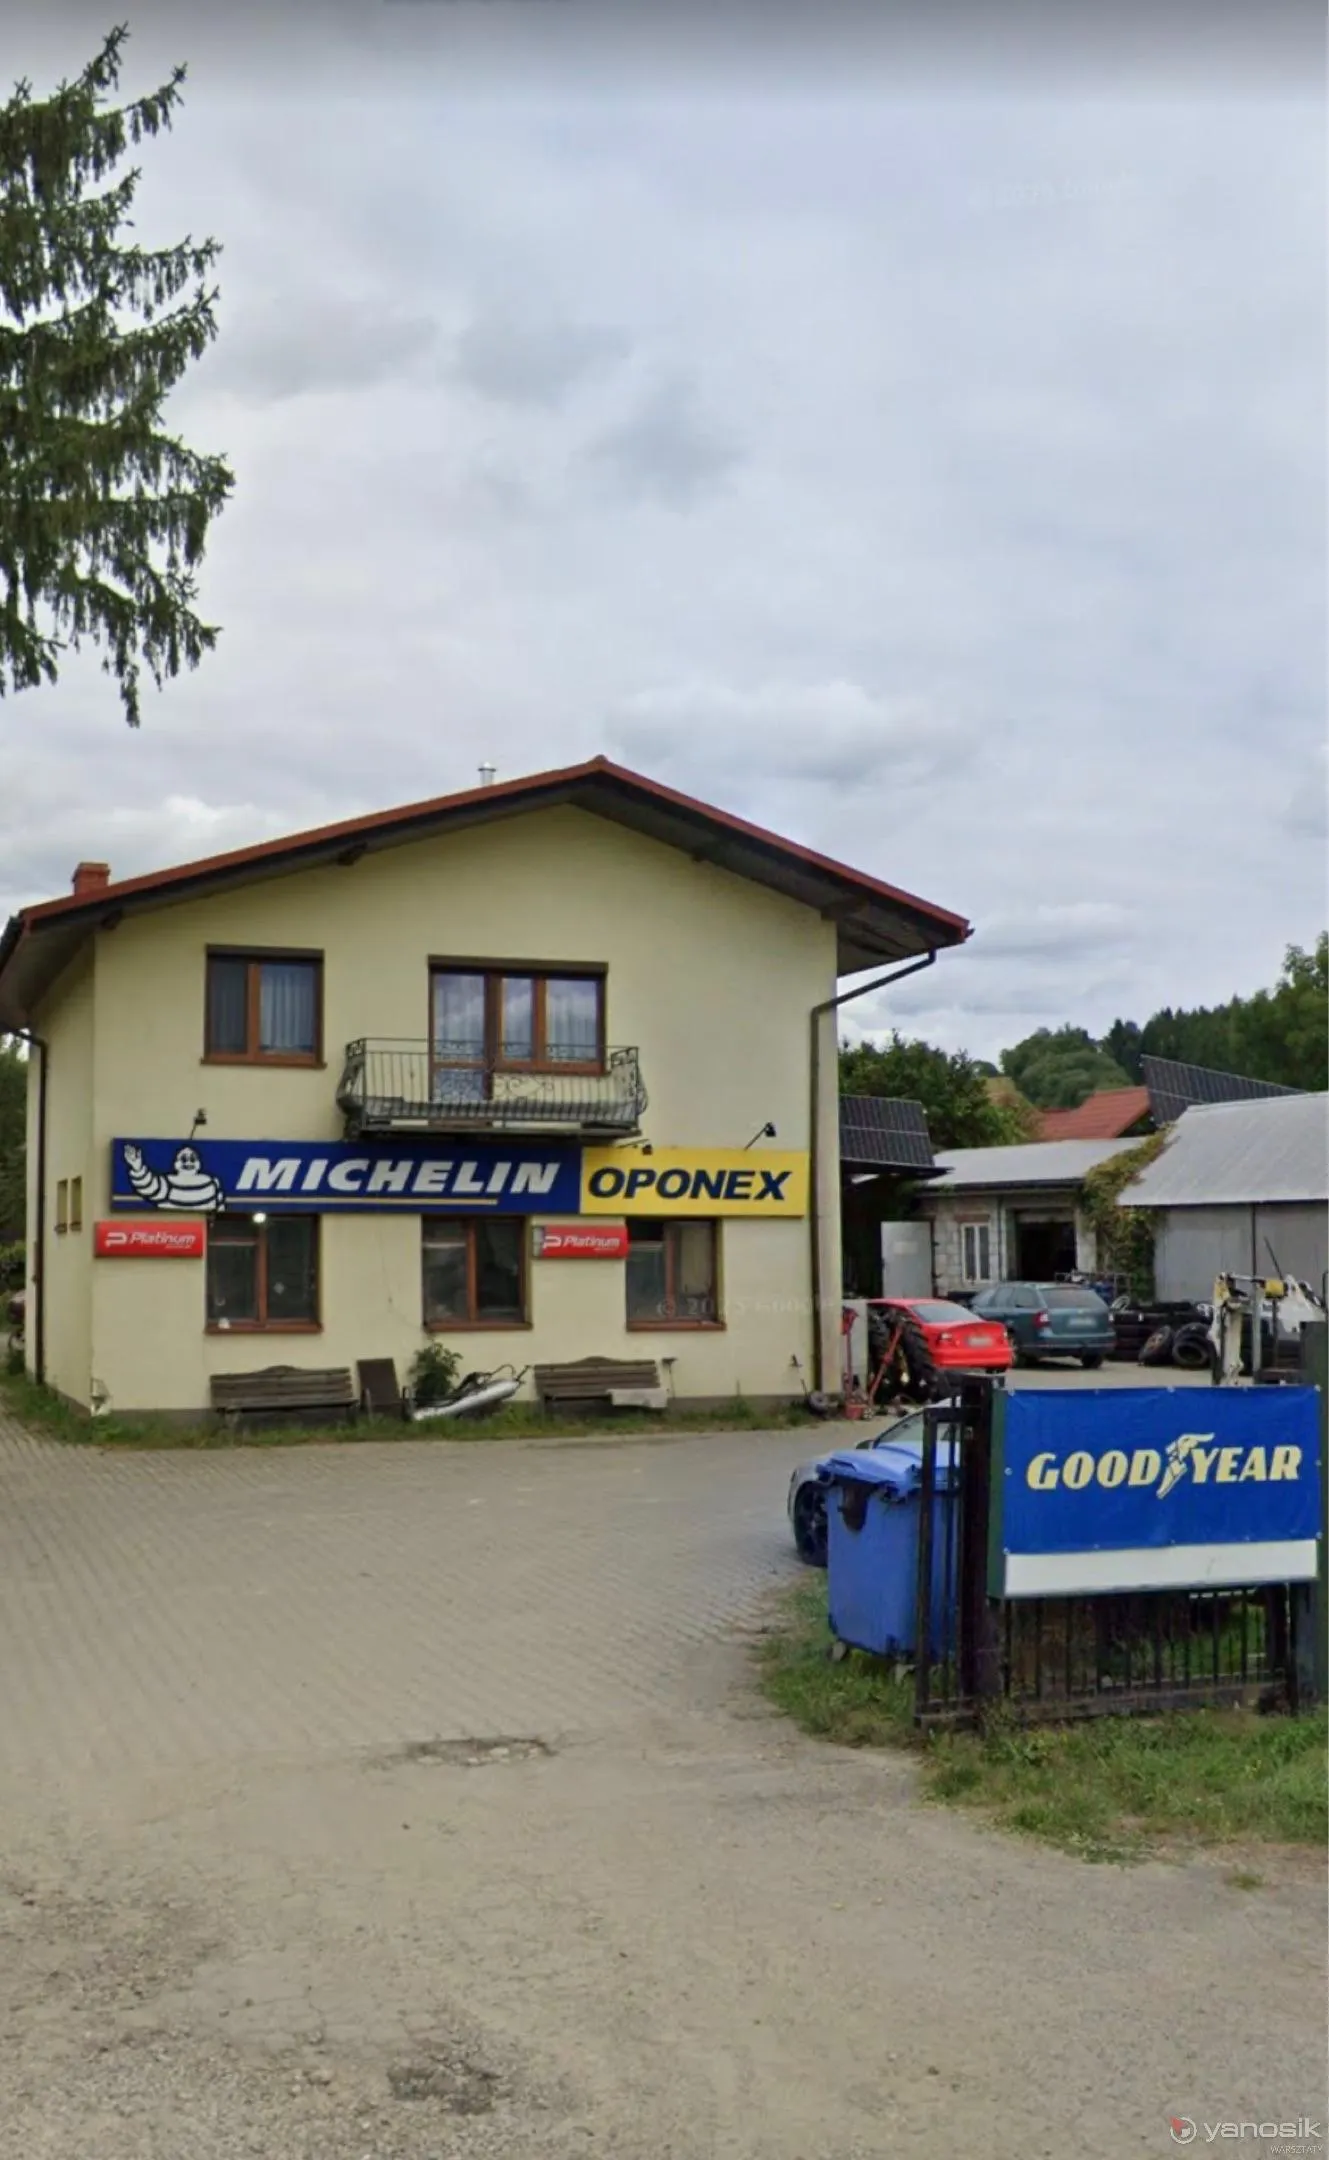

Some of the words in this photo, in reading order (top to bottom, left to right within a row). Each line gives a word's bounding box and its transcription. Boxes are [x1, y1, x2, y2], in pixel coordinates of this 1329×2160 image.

[236, 1157, 561, 1194] MICHELIN
[589, 1167, 792, 1200] OPONEX
[130, 1231, 196, 1245] Platinum
[562, 1235, 621, 1249] Platinum
